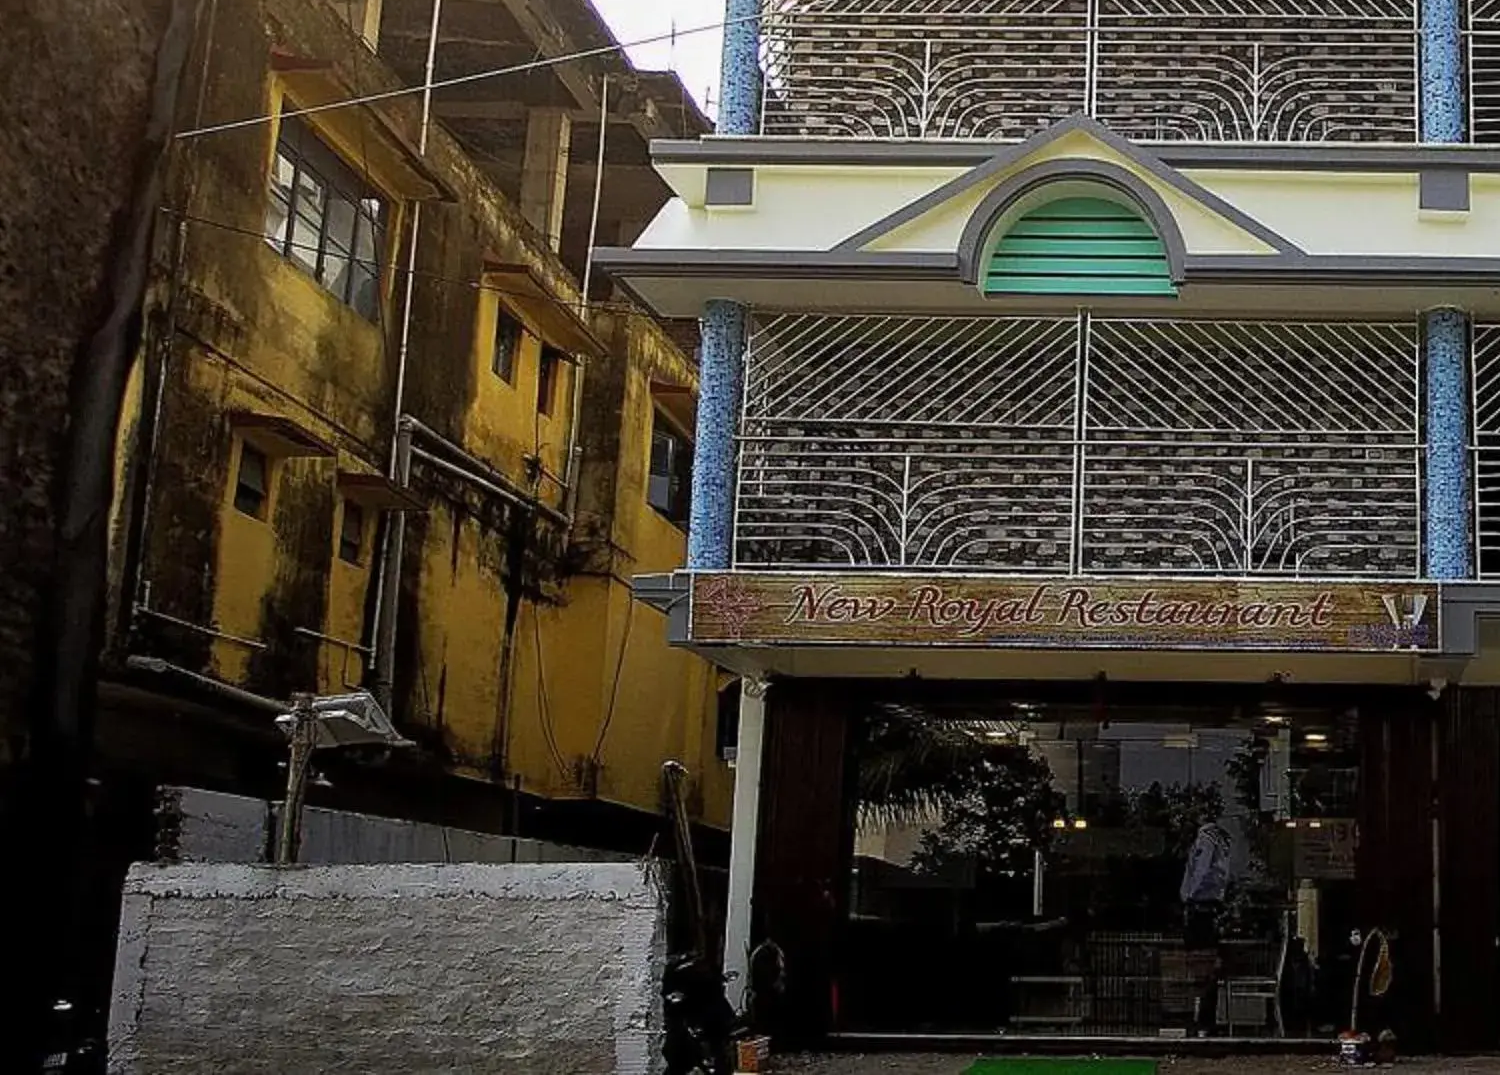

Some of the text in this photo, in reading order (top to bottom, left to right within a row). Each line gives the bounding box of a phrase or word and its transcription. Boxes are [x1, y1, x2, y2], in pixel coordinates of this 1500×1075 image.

[783, 581, 1337, 637] New Royal Restaurant
